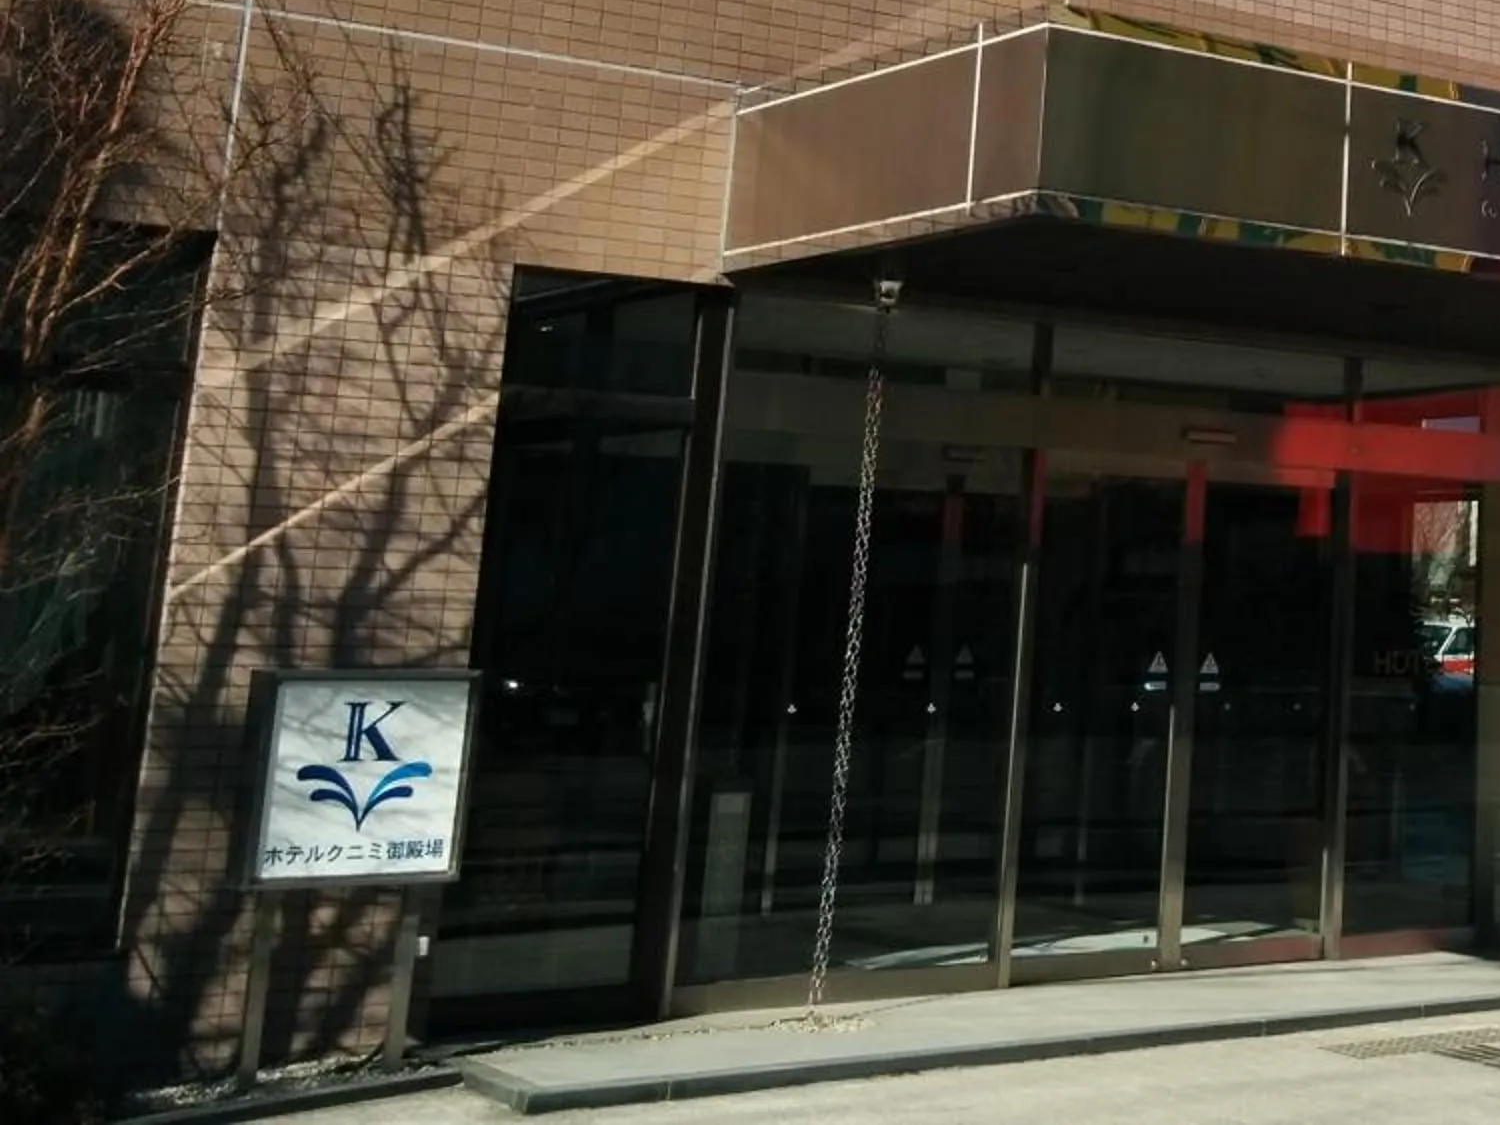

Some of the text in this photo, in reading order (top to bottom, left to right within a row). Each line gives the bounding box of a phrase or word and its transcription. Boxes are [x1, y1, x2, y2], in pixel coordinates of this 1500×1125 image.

[337, 700, 406, 762] K
[264, 838, 444, 866] ホテルクニミ御殿場
